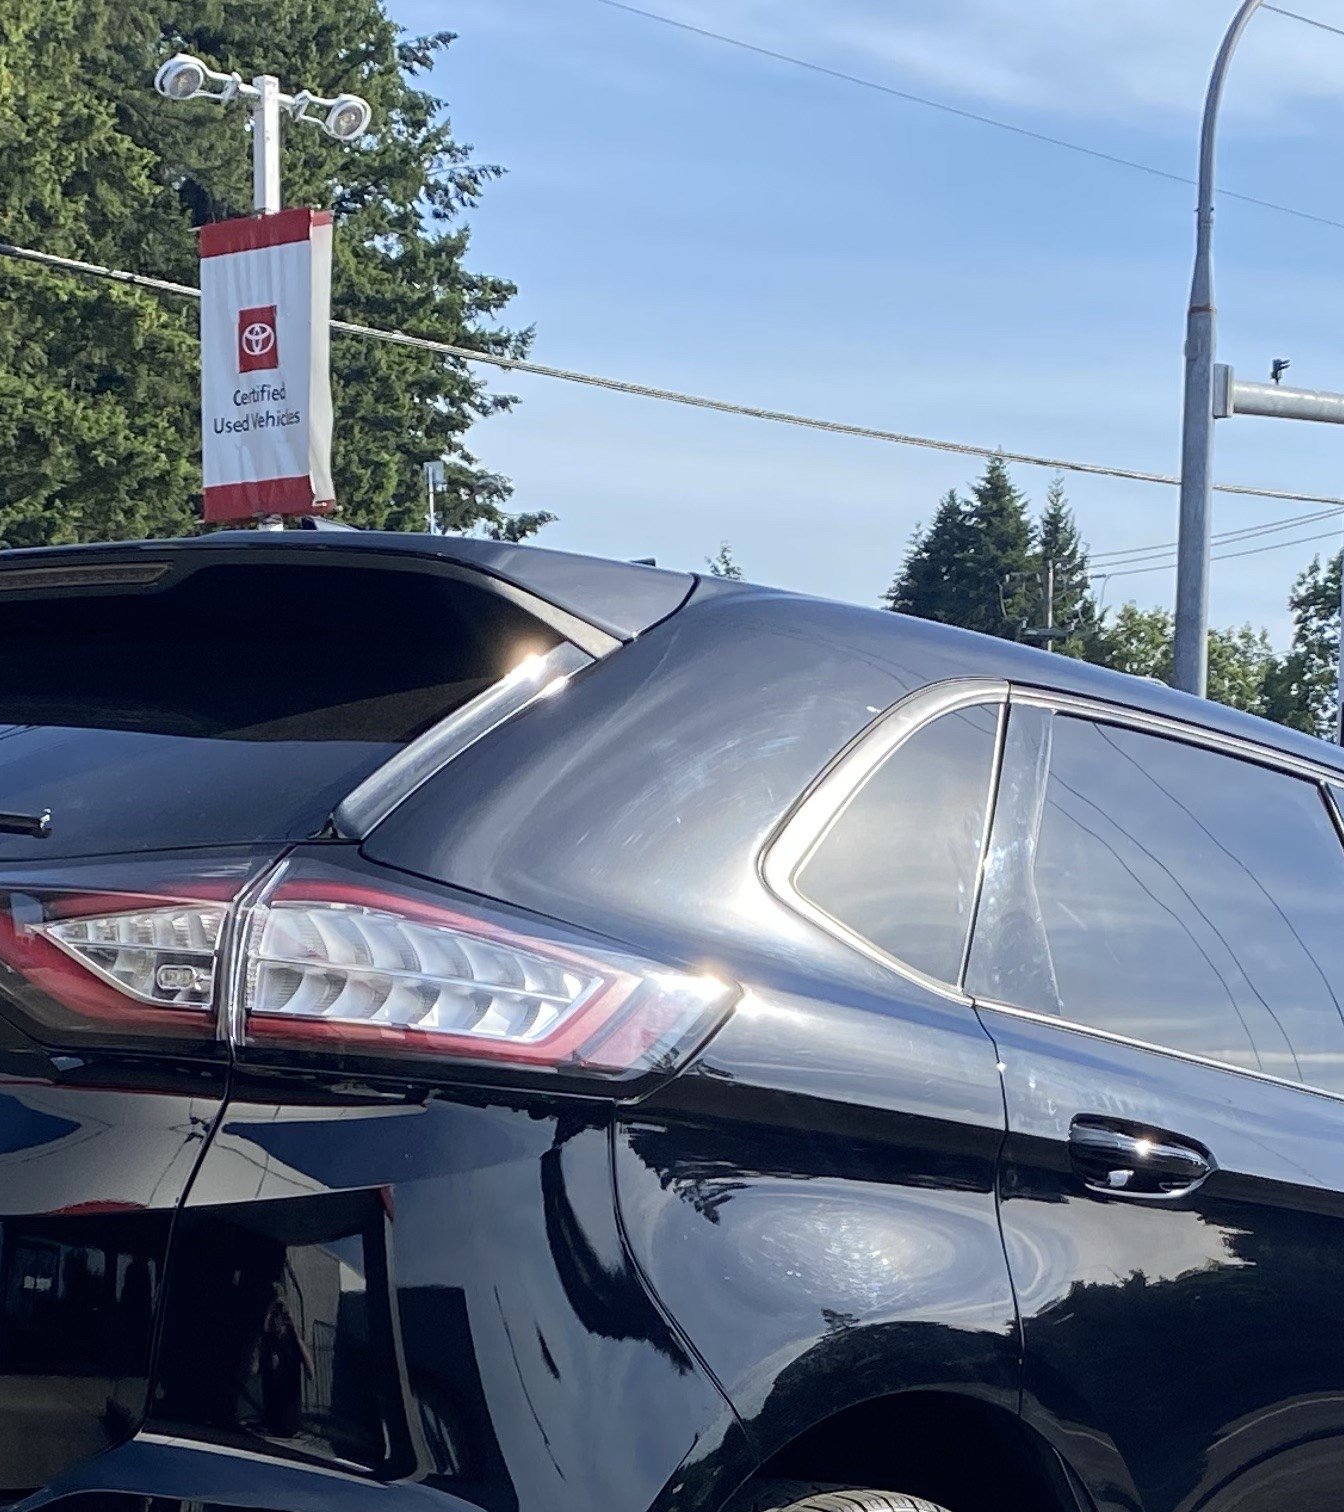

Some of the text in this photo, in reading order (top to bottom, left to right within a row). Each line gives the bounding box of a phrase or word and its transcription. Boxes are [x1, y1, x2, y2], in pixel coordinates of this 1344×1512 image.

[233, 382, 286, 406] Certified
[213, 409, 301, 434] Used Vehicles
